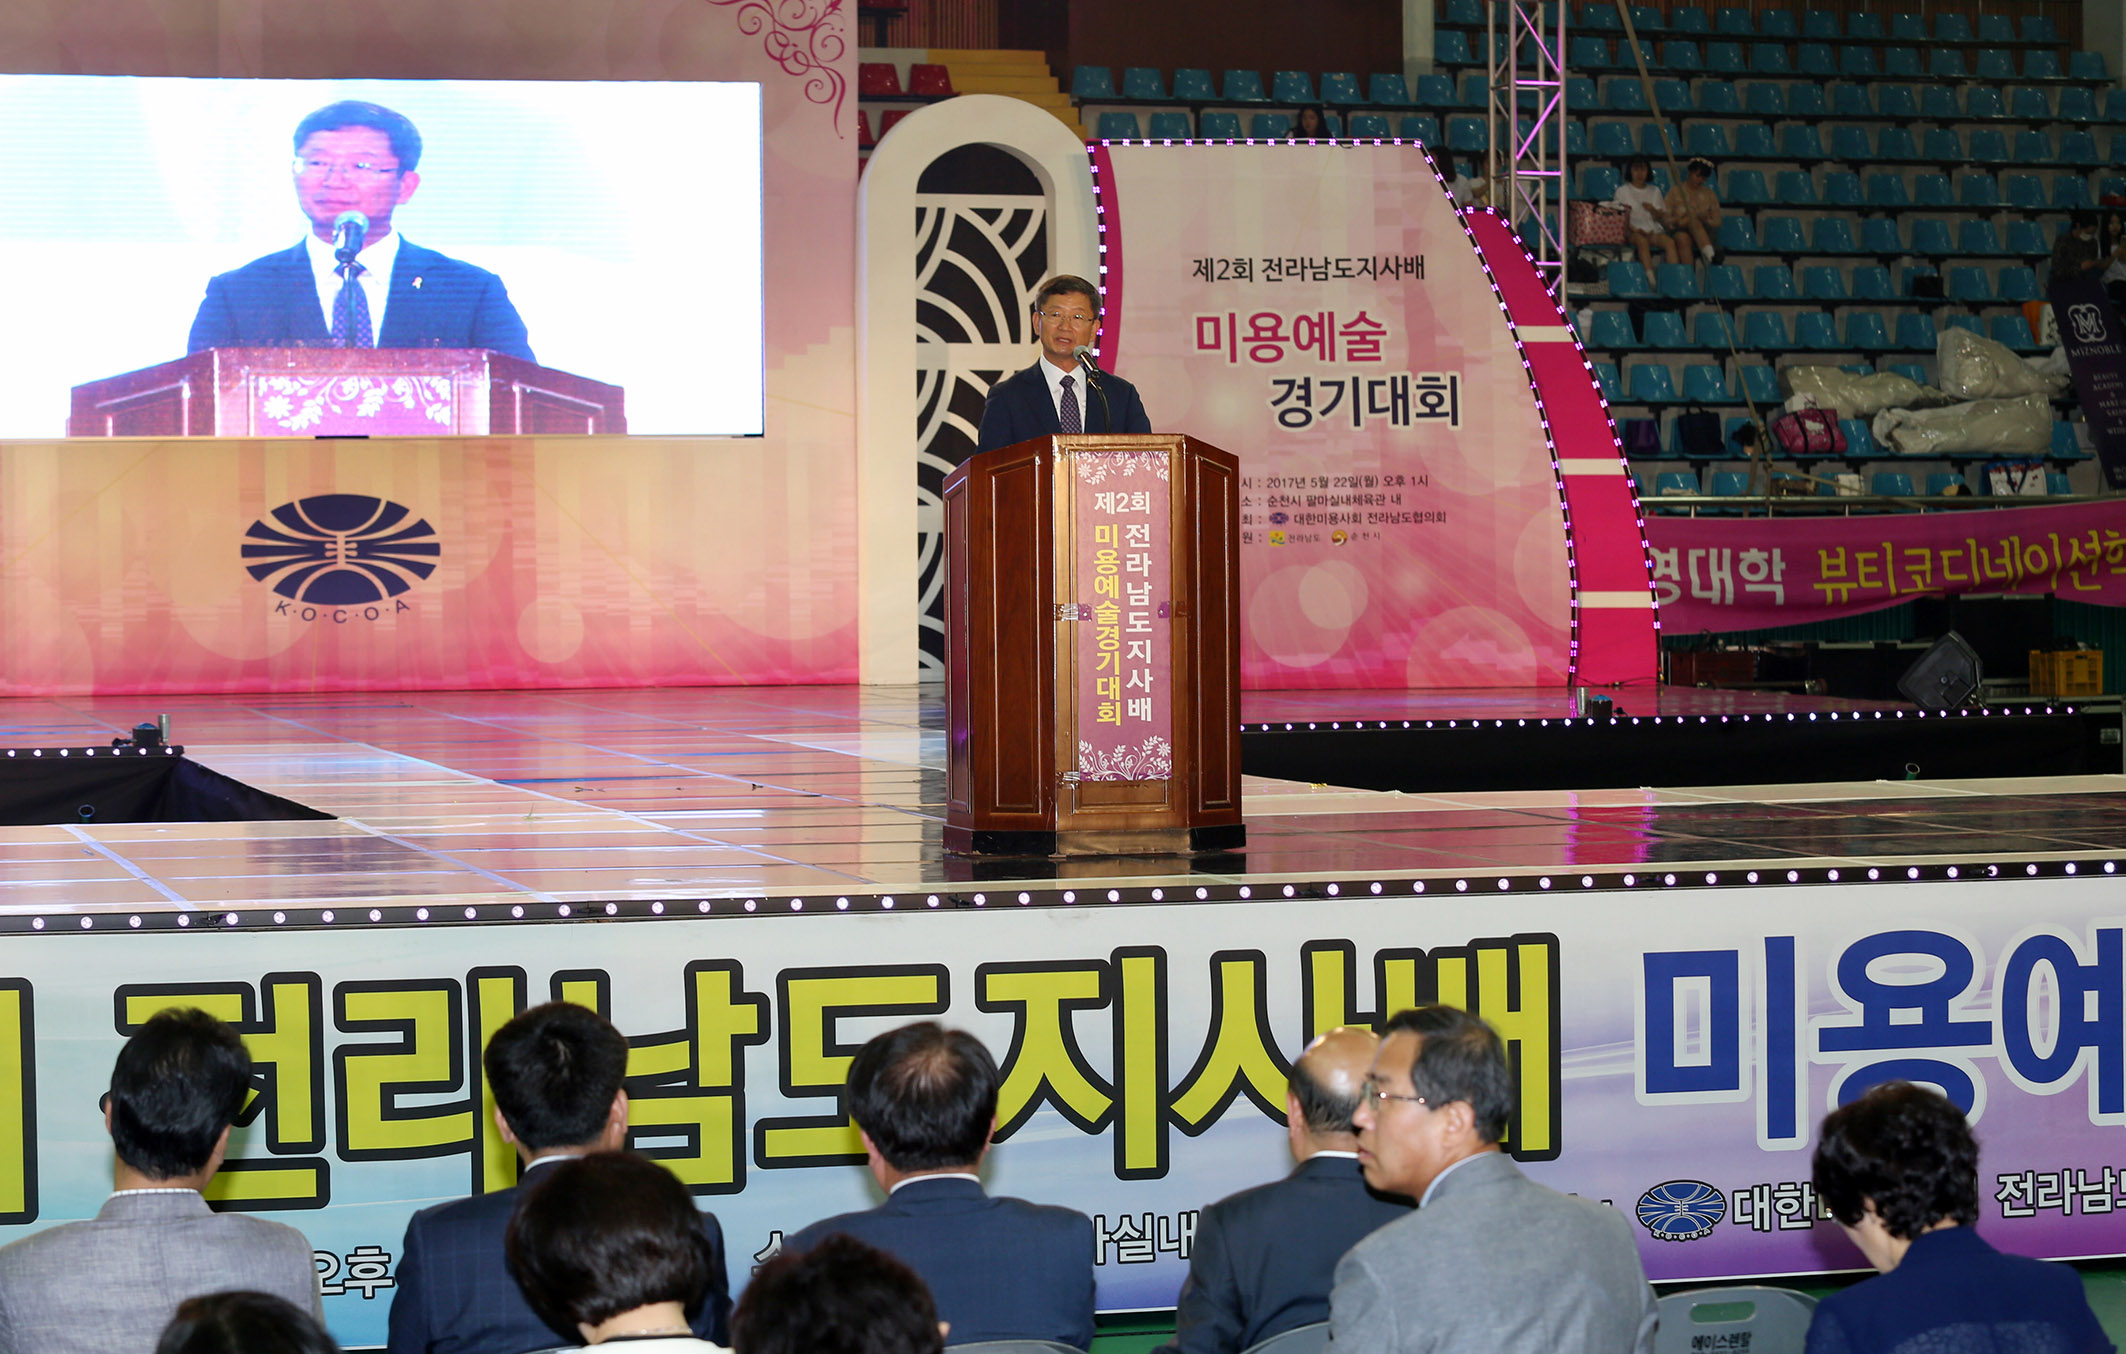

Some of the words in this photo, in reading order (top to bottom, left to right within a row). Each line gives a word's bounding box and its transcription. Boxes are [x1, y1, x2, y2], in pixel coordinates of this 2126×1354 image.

[1192, 257, 1254, 283] 제2회
[1261, 255, 1425, 282] 전라남도지사배
[1195, 310, 1388, 364] 미용예술
[2070, 344, 2123, 358] MIZNOBLE
[1270, 375, 1460, 429] 경기대회
[1266, 476, 1306, 489] 2017년
[1310, 476, 1329, 489] 5월
[1333, 475, 1379, 489] 22일(월)
[1383, 475, 1406, 488] 오후
[1411, 475, 1429, 488] 1시
[1093, 491, 1151, 515] 제2회
[1267, 495, 1301, 507] 순천시
[1306, 494, 1386, 507] 팔마실내체육관
[1390, 493, 1402, 506] 내
[1294, 512, 1362, 526] 대한미용사회
[1367, 511, 1447, 525] 전라남도협의회
[1288, 533, 1321, 544] 전라남도
[1648, 547, 1786, 607] 영대학
[1093, 523, 1121, 726] 미용예술경기대회
[1124, 523, 1154, 722] 전라남도지사배
[1993, 1166, 2126, 1219] 전라남
[1691, 1331, 1752, 1350] 에이스렌탈
